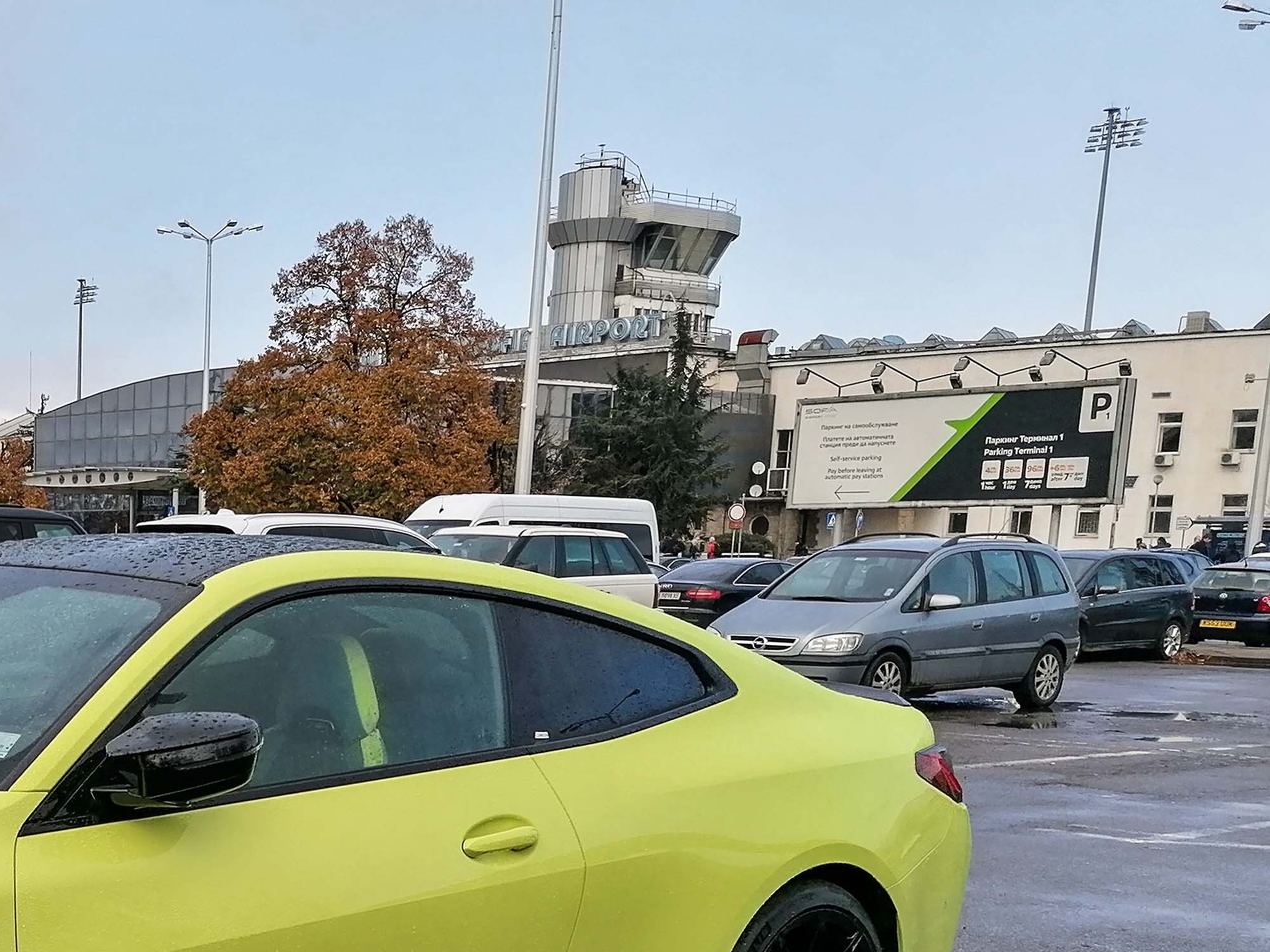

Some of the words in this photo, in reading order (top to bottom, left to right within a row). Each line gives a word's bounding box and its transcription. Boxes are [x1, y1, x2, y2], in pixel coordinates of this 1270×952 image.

[550, 314, 664, 347] AIRPORT
[1091, 393, 1112, 420] P
[985, 436, 1018, 445] Паркинг
[1019, 434, 1059, 444] Терминал
[1059, 433, 1064, 441] 1
[983, 448, 1013, 457] Parking
[1014, 445, 1048, 454] Terminal
[1048, 445, 1053, 454] 1
[861, 454, 882, 462] parking
